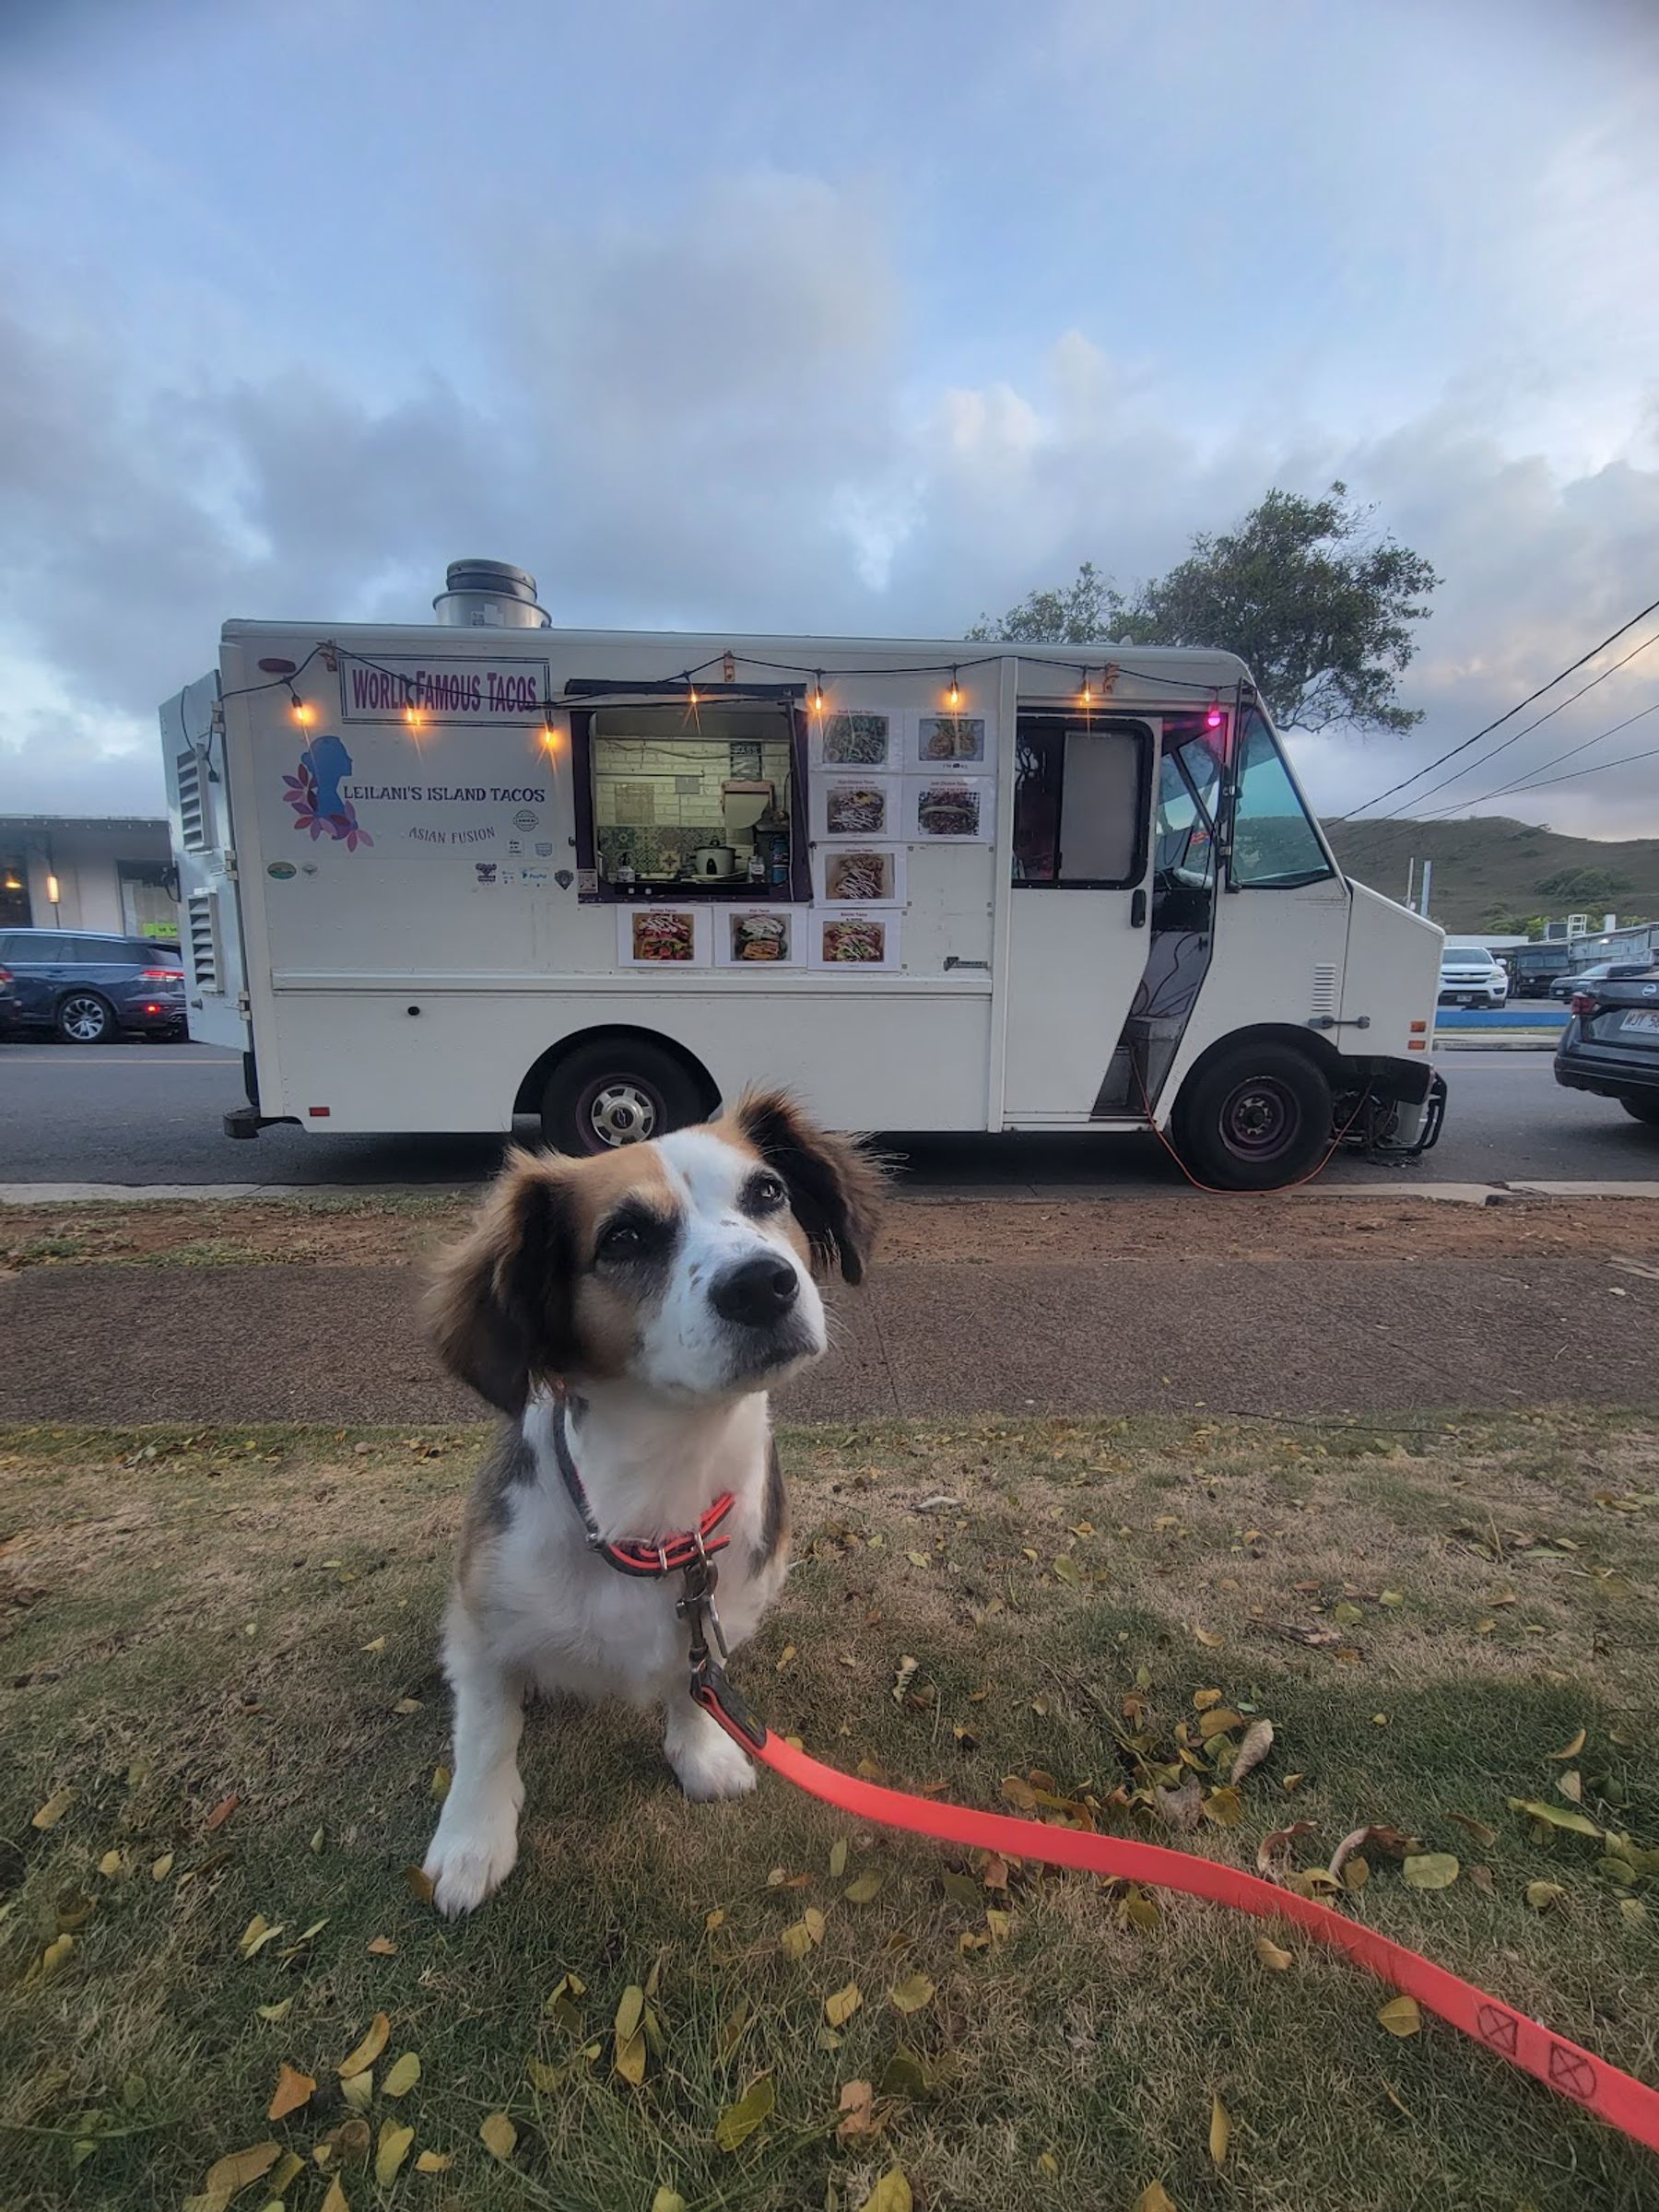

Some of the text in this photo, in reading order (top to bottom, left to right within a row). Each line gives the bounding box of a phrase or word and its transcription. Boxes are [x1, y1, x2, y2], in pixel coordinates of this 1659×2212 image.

[352, 669, 537, 712] WORLD FAMOUS TACOS
[344, 786, 546, 803] LEILANI'S ISLAND TACOS
[408, 826, 495, 844] ASIAN FUSION
